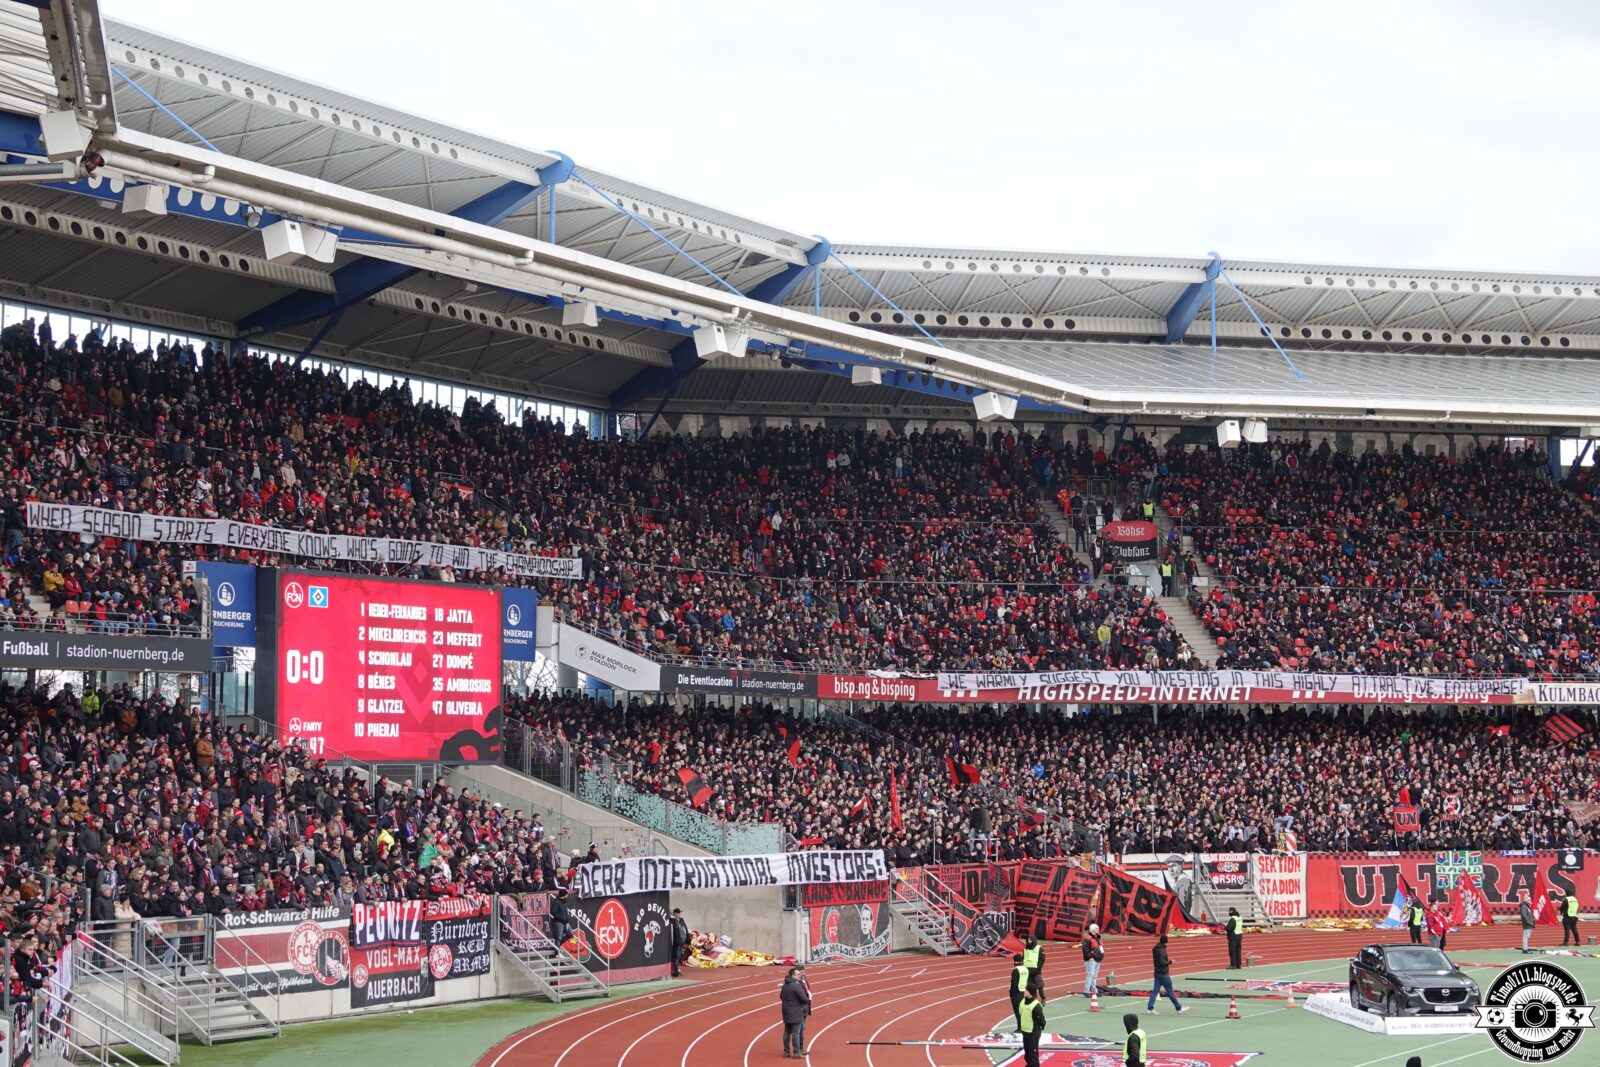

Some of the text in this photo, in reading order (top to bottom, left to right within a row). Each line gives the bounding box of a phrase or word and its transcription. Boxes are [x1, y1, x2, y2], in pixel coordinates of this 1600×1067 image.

[29, 503, 72, 530] WHEN
[83, 509, 142, 538] SEASON
[153, 520, 216, 543] STARTS
[227, 523, 291, 552] EVERYONE
[346, 538, 378, 559] WHO'S
[388, 541, 423, 563] GOING
[430, 545, 444, 565] TO
[452, 547, 471, 570] WIN
[480, 551, 498, 572] THE
[1116, 525, 1146, 537] Böhse
[212, 609, 252, 621] RNBERGER
[361, 602, 365, 617] 1
[434, 607, 473, 624] 18 JATTA
[212, 620, 245, 629] RSICHERUNG
[503, 628, 533, 639] RNBERGER
[358, 626, 427, 644] 2 MIKELBRENCIS
[433, 630, 483, 647] 23 MEFFERT
[3, 640, 186, 663] Fußball stadion-nuernberg.de
[358, 650, 412, 667] 4 SCHONLAU
[286, 649, 324, 685] 0:0
[432, 652, 474, 670] 27 DOMPÉ
[589, 655, 617, 671] STADION
[591, 650, 638, 673] MAX MORLOCK
[358, 674, 365, 689] 8
[432, 677, 492, 693] 35 AMBROSIUS
[677, 673, 804, 692] Die Eventlocation stadion-nuernberg.de
[872, 679, 880, 694] &
[880, 678, 915, 700] bisping
[976, 673, 1028, 689] WARMLY
[1040, 671, 1099, 686] SUGGEST
[1117, 671, 1140, 686] YOU
[1150, 670, 1219, 688] INVESTING
[1231, 670, 1243, 686] IN
[1253, 672, 1283, 689] THIS
[1292, 673, 1338, 691] HIGHLY
[1351, 674, 1435, 695] ATTRACTIVE
[1443, 678, 1524, 696] ENTERPRISE!
[1017, 684, 1254, 702] HIGHSPEED-INTERNET
[358, 698, 406, 714] 9 GLATZEL
[432, 700, 483, 716] 47 OLIVEIRA
[354, 722, 400, 738] 10 PHERAI
[1395, 811, 1417, 827] UN
[1258, 855, 1301, 873] SEKTION
[581, 860, 626, 898] DEAR
[638, 856, 778, 890] INTERNATIONAL
[786, 851, 884, 882] INVESTORS:
[1219, 874, 1237, 884] RSR
[1259, 878, 1301, 895] STADION
[224, 905, 340, 927] Rot-Schwarze Hilfe
[355, 900, 421, 945] PEGNITZ
[633, 903, 670, 931] RED DEVILS
[430, 919, 488, 943] Nürnberg
[600, 926, 625, 945] FCN
[457, 940, 486, 954] RED
[366, 946, 420, 969] VOGL-MAX
[453, 954, 490, 973] ARMY
[366, 976, 420, 1001] AUERBACH
[1339, 996, 1351, 1004] Au
